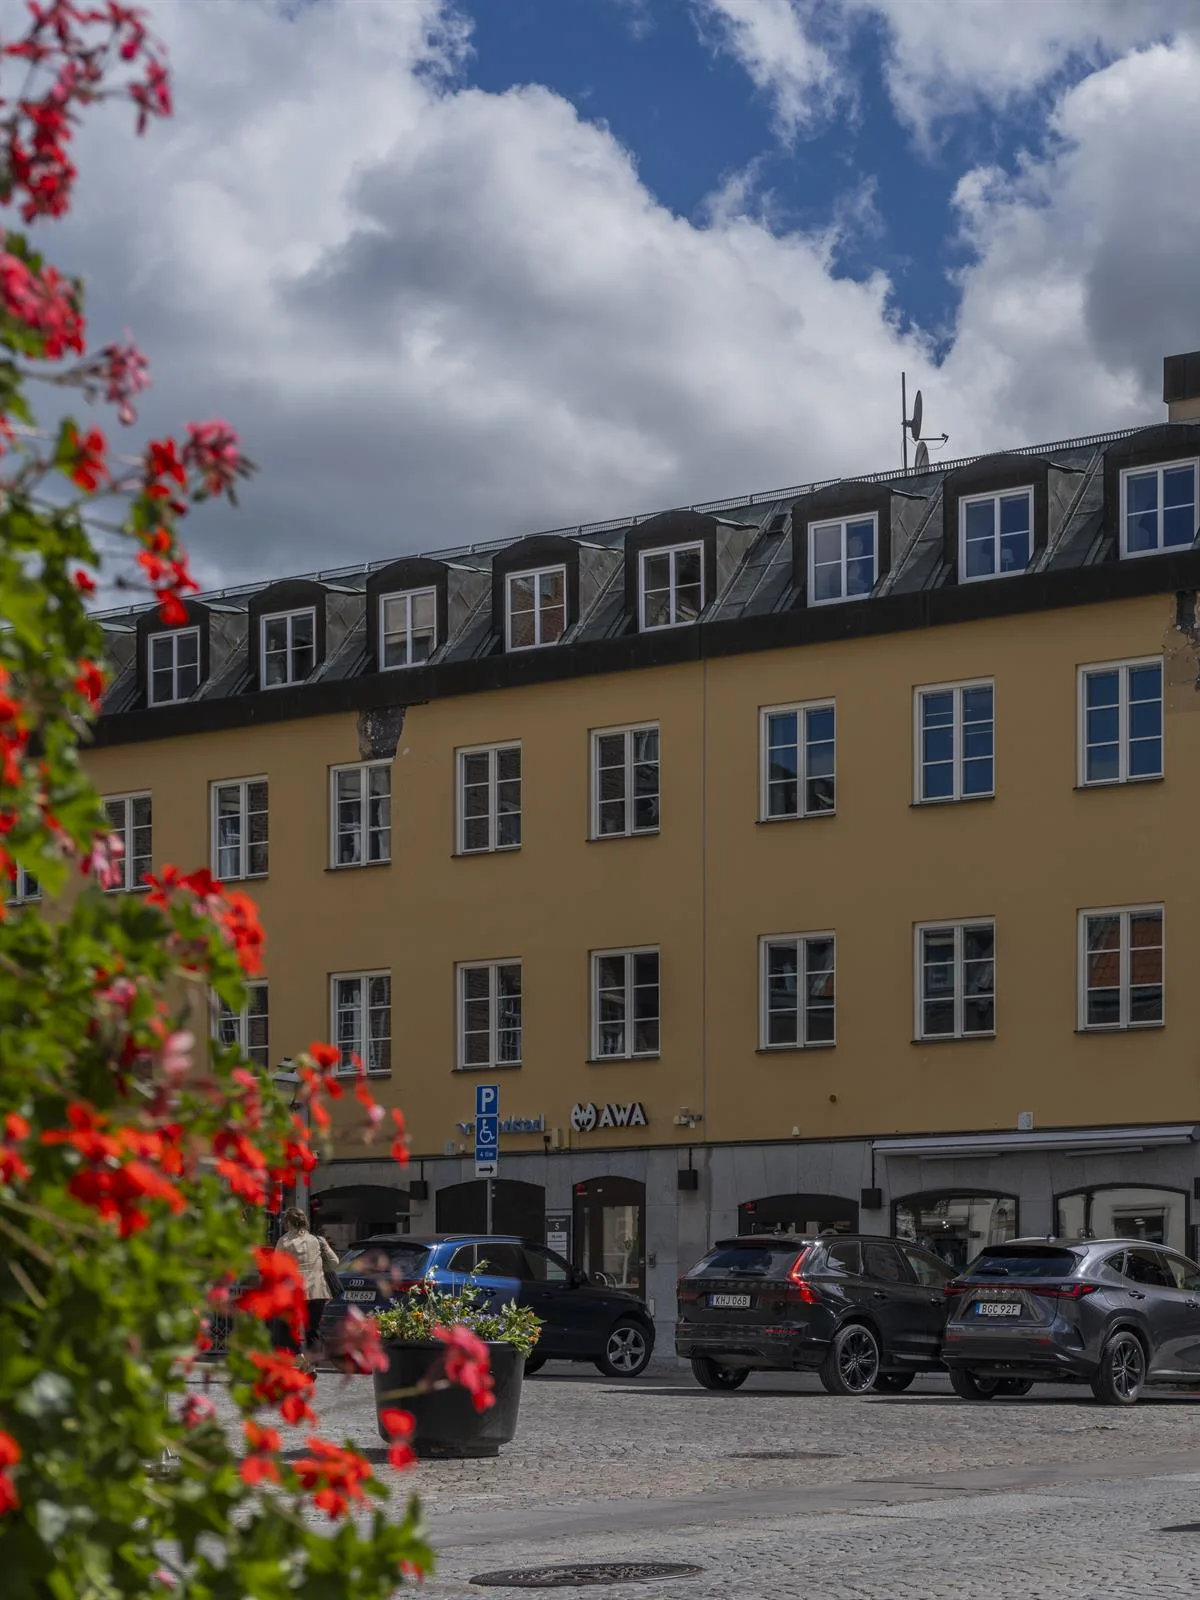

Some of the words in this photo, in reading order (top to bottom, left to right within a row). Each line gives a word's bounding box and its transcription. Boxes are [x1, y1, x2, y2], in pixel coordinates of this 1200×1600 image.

[481, 1088, 495, 1112] P
[598, 1103, 648, 1128] AWA
[982, 1304, 998, 1314] BGC
[1000, 1304, 1017, 1314] 92F
